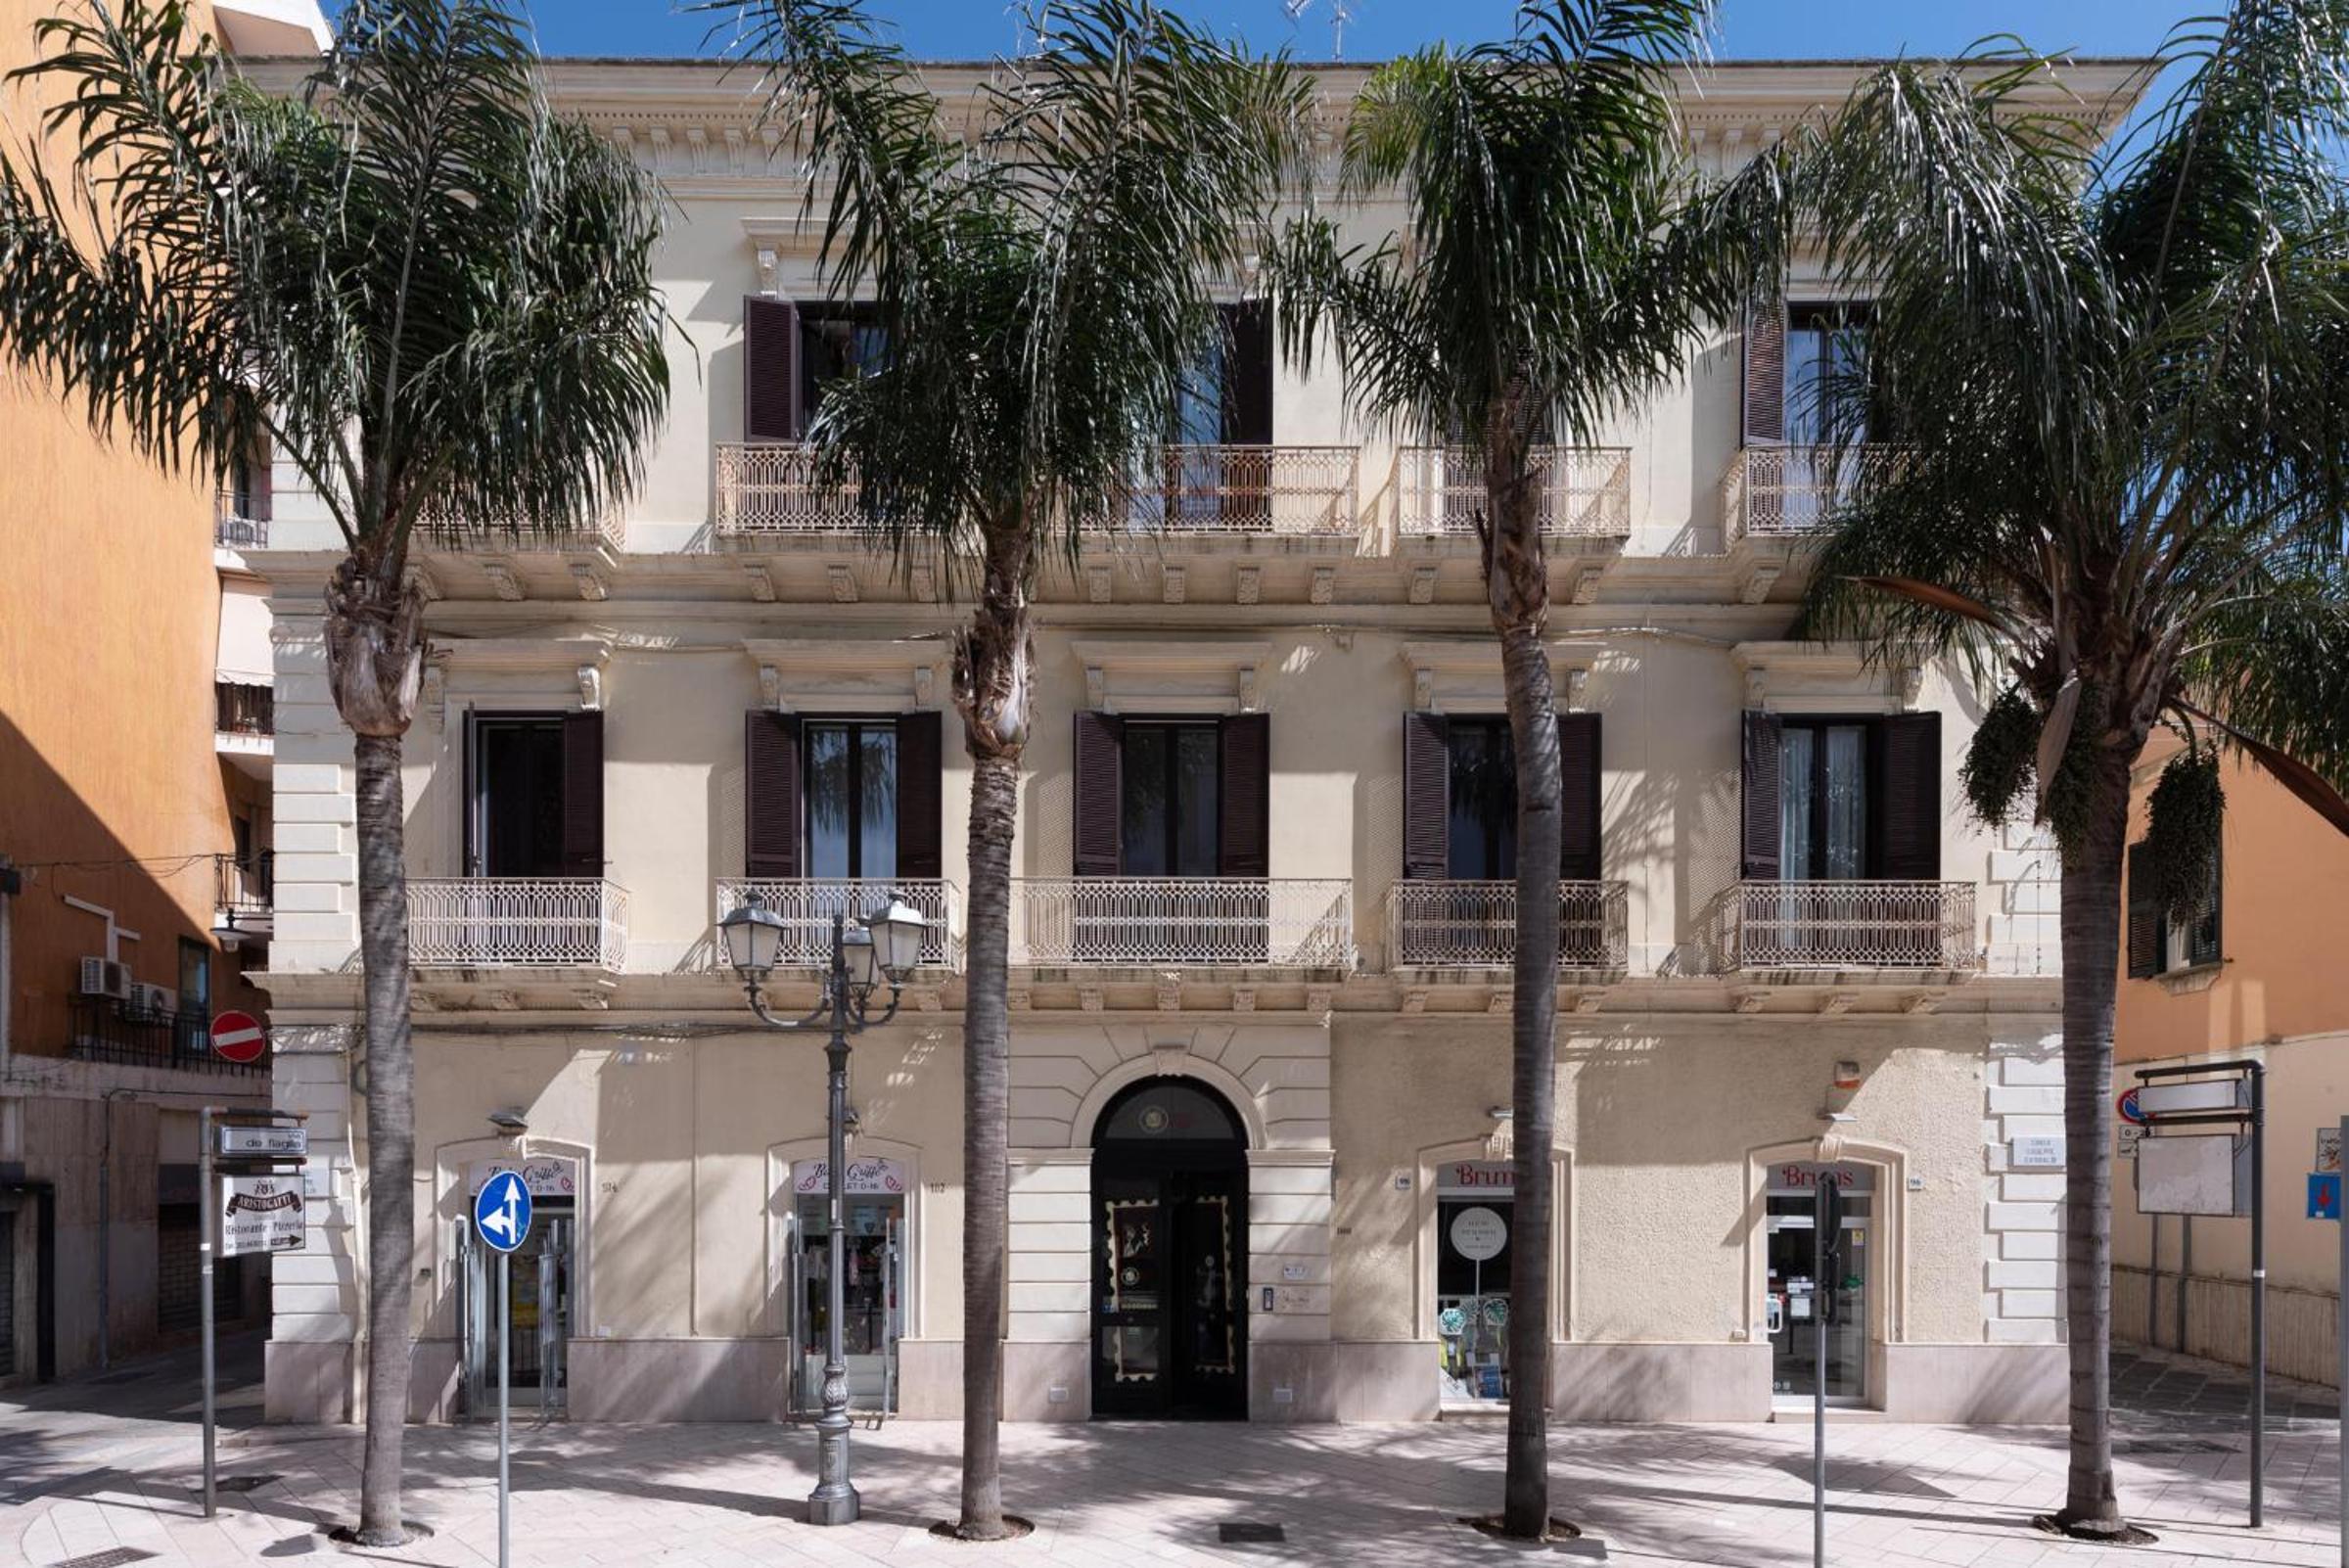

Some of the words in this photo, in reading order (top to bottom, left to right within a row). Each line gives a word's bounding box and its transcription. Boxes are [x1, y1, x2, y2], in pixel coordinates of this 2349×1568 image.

[1456, 1164, 1517, 1185] Brun
[1782, 1165, 1854, 1186] Brs
[225, 1222, 267, 1235] Ristorante
[274, 1221, 303, 1232] Pizzeria
